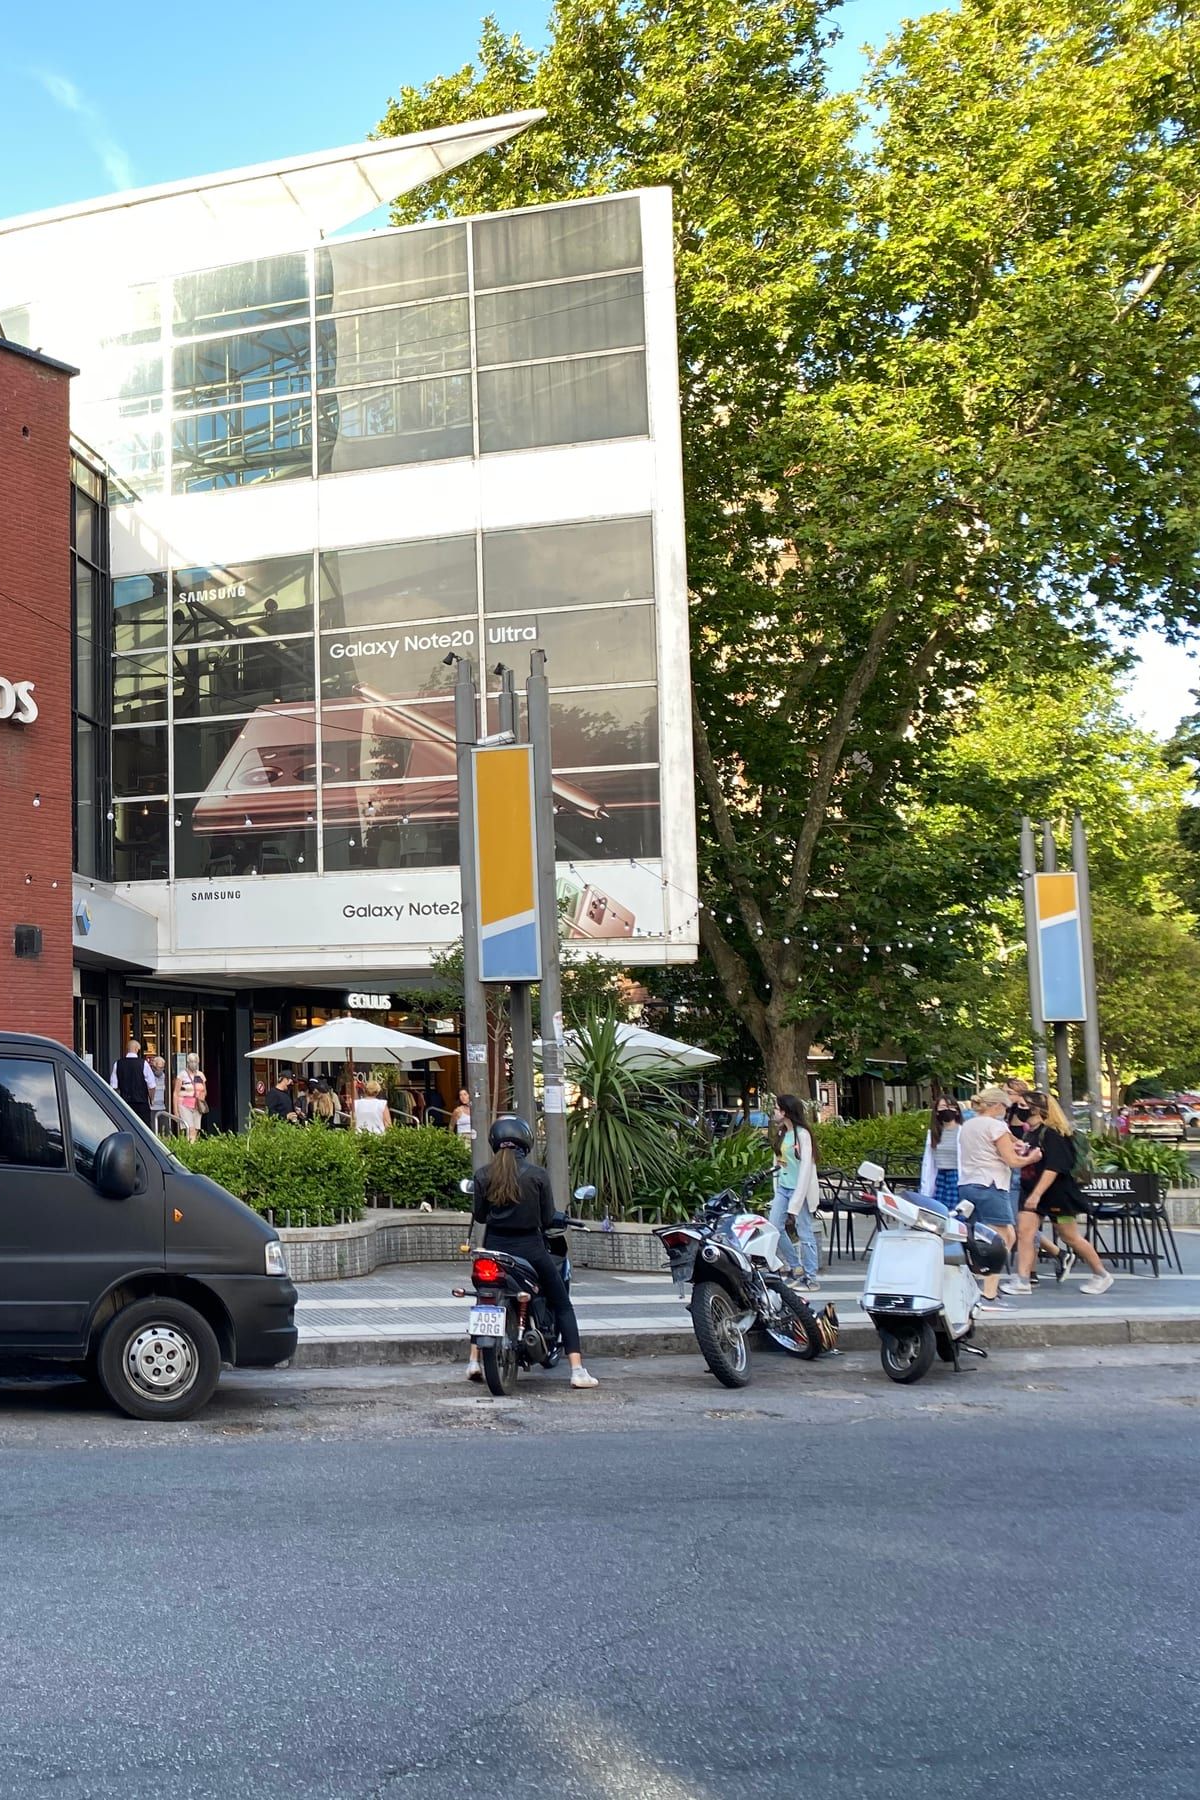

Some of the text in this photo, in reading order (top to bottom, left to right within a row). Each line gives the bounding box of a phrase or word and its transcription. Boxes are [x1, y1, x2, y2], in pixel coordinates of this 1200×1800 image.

[179, 585, 246, 604] SAMSUNG
[329, 626, 537, 659] Galaxy Note20 Ultra
[191, 890, 241, 901] SAMSUNG
[342, 901, 462, 921] Galaxy Note2
